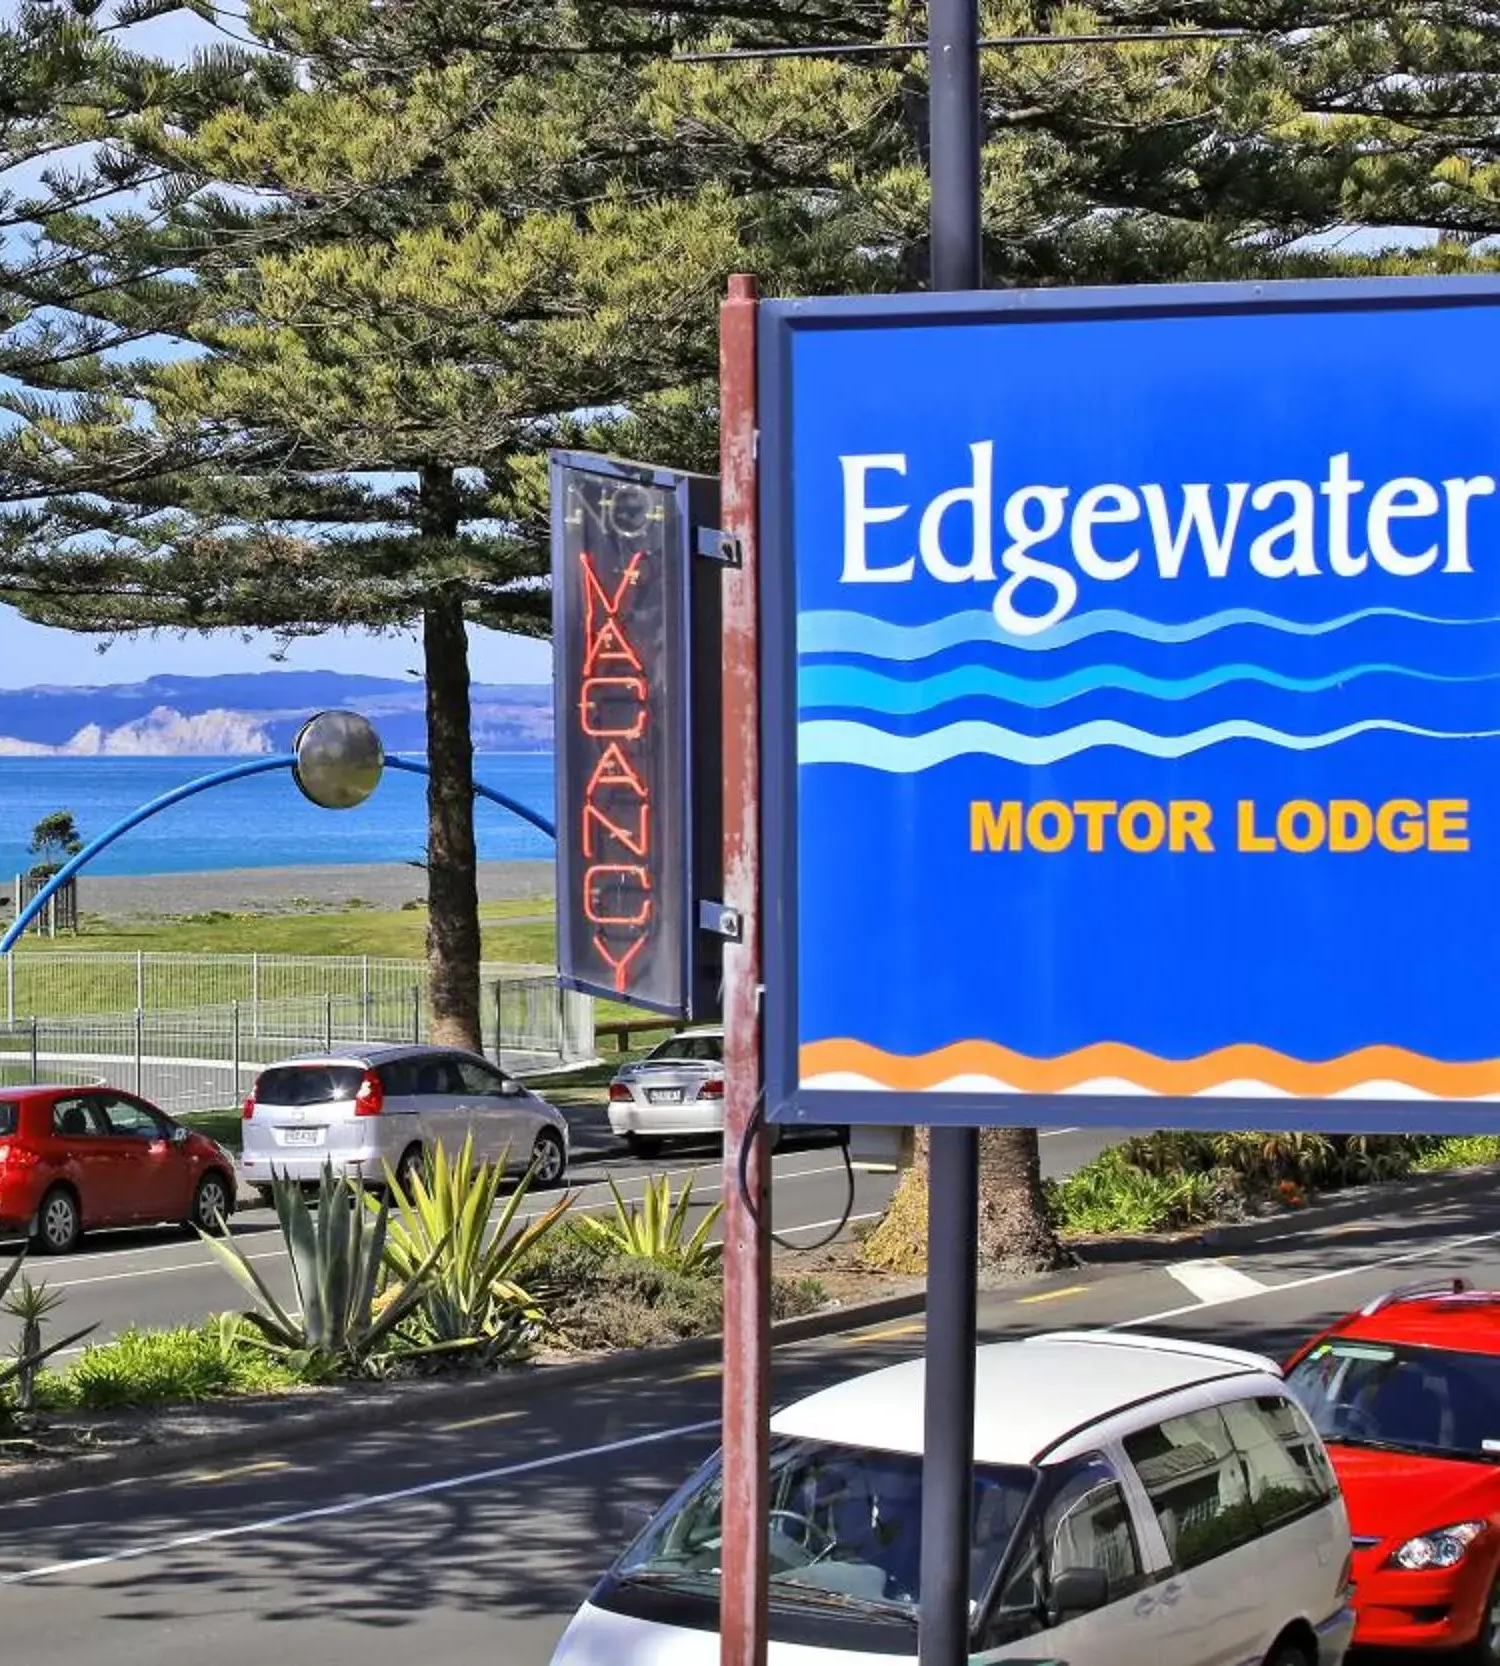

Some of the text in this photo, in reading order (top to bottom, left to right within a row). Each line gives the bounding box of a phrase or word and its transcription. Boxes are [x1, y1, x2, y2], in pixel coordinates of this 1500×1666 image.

[838, 439, 1496, 636] Edgewater
[580, 551, 650, 993] VACANCY
[969, 800, 1470, 852] MOTOR LODGE
